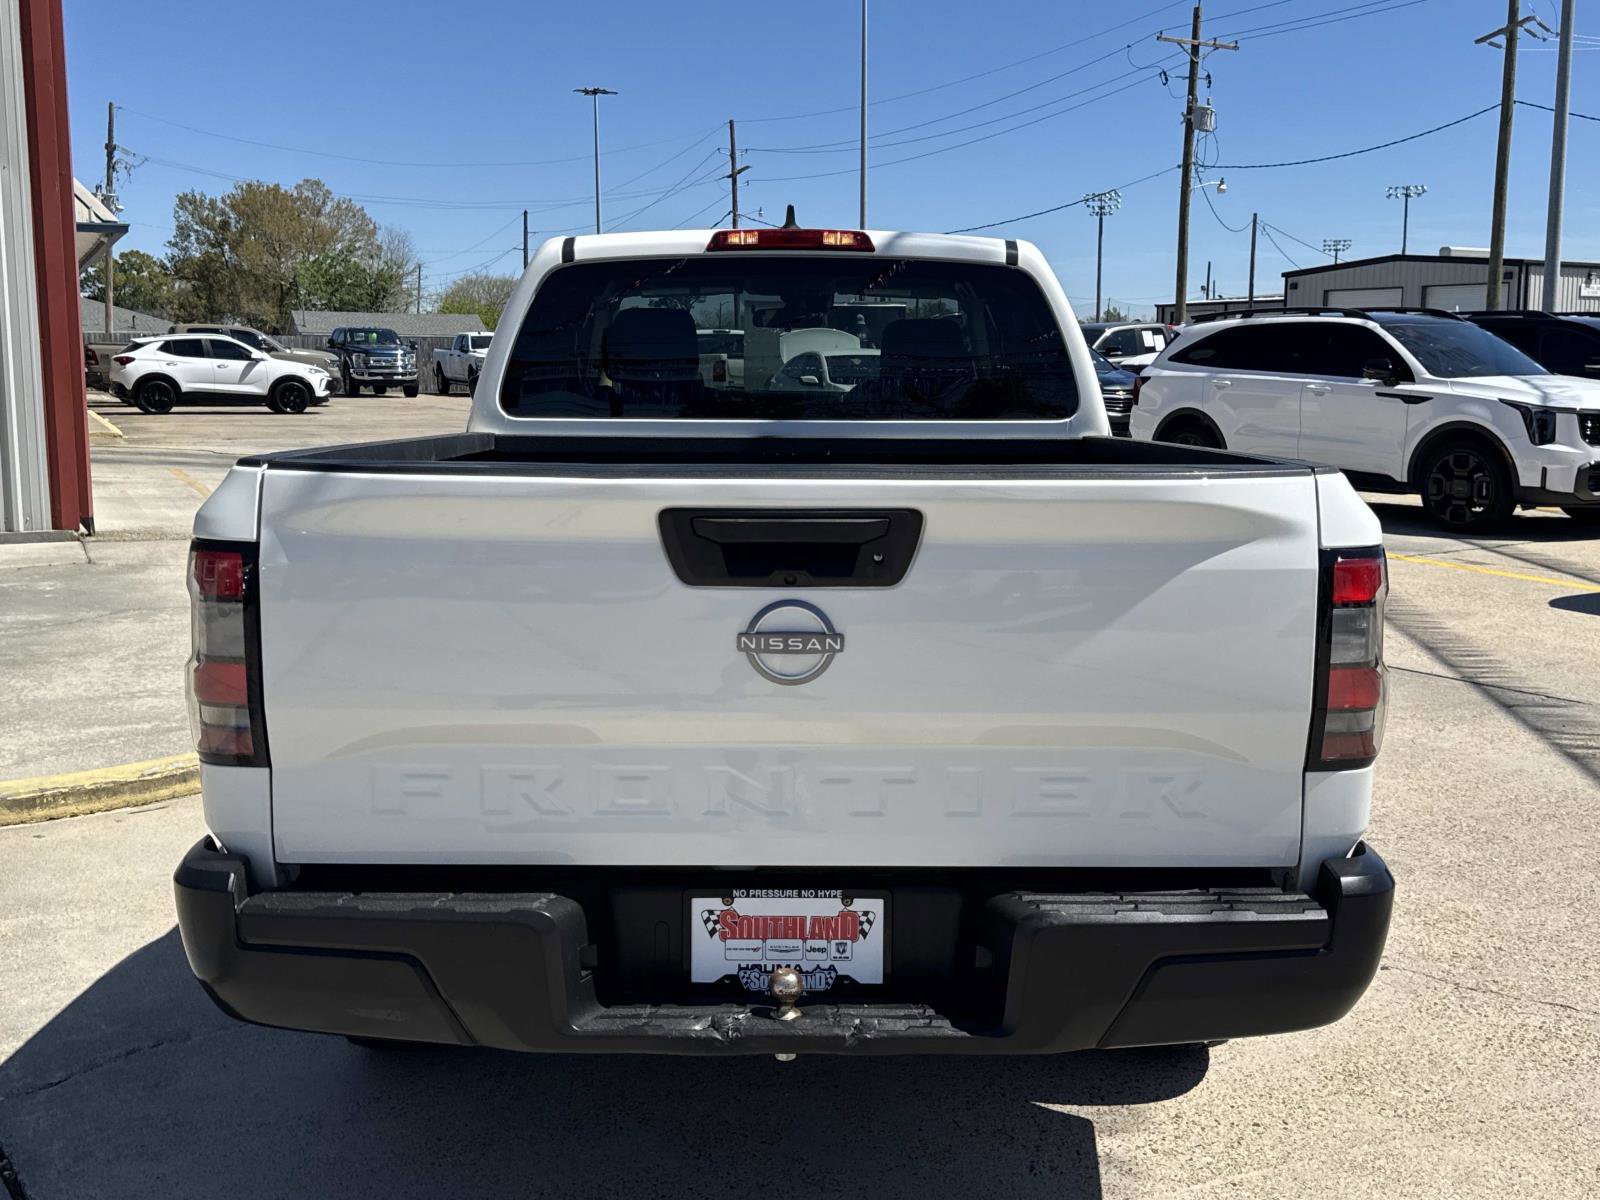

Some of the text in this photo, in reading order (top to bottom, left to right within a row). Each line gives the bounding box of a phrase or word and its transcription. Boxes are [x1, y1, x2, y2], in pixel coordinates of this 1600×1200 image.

[740, 636, 841, 651] NISSAN
[371, 764, 1207, 816] FRONTIER
[732, 889, 843, 898] NO PRESSURE NO HYPE
[719, 910, 860, 942] SOUTHLAND
[806, 945, 827, 954] Jeep
